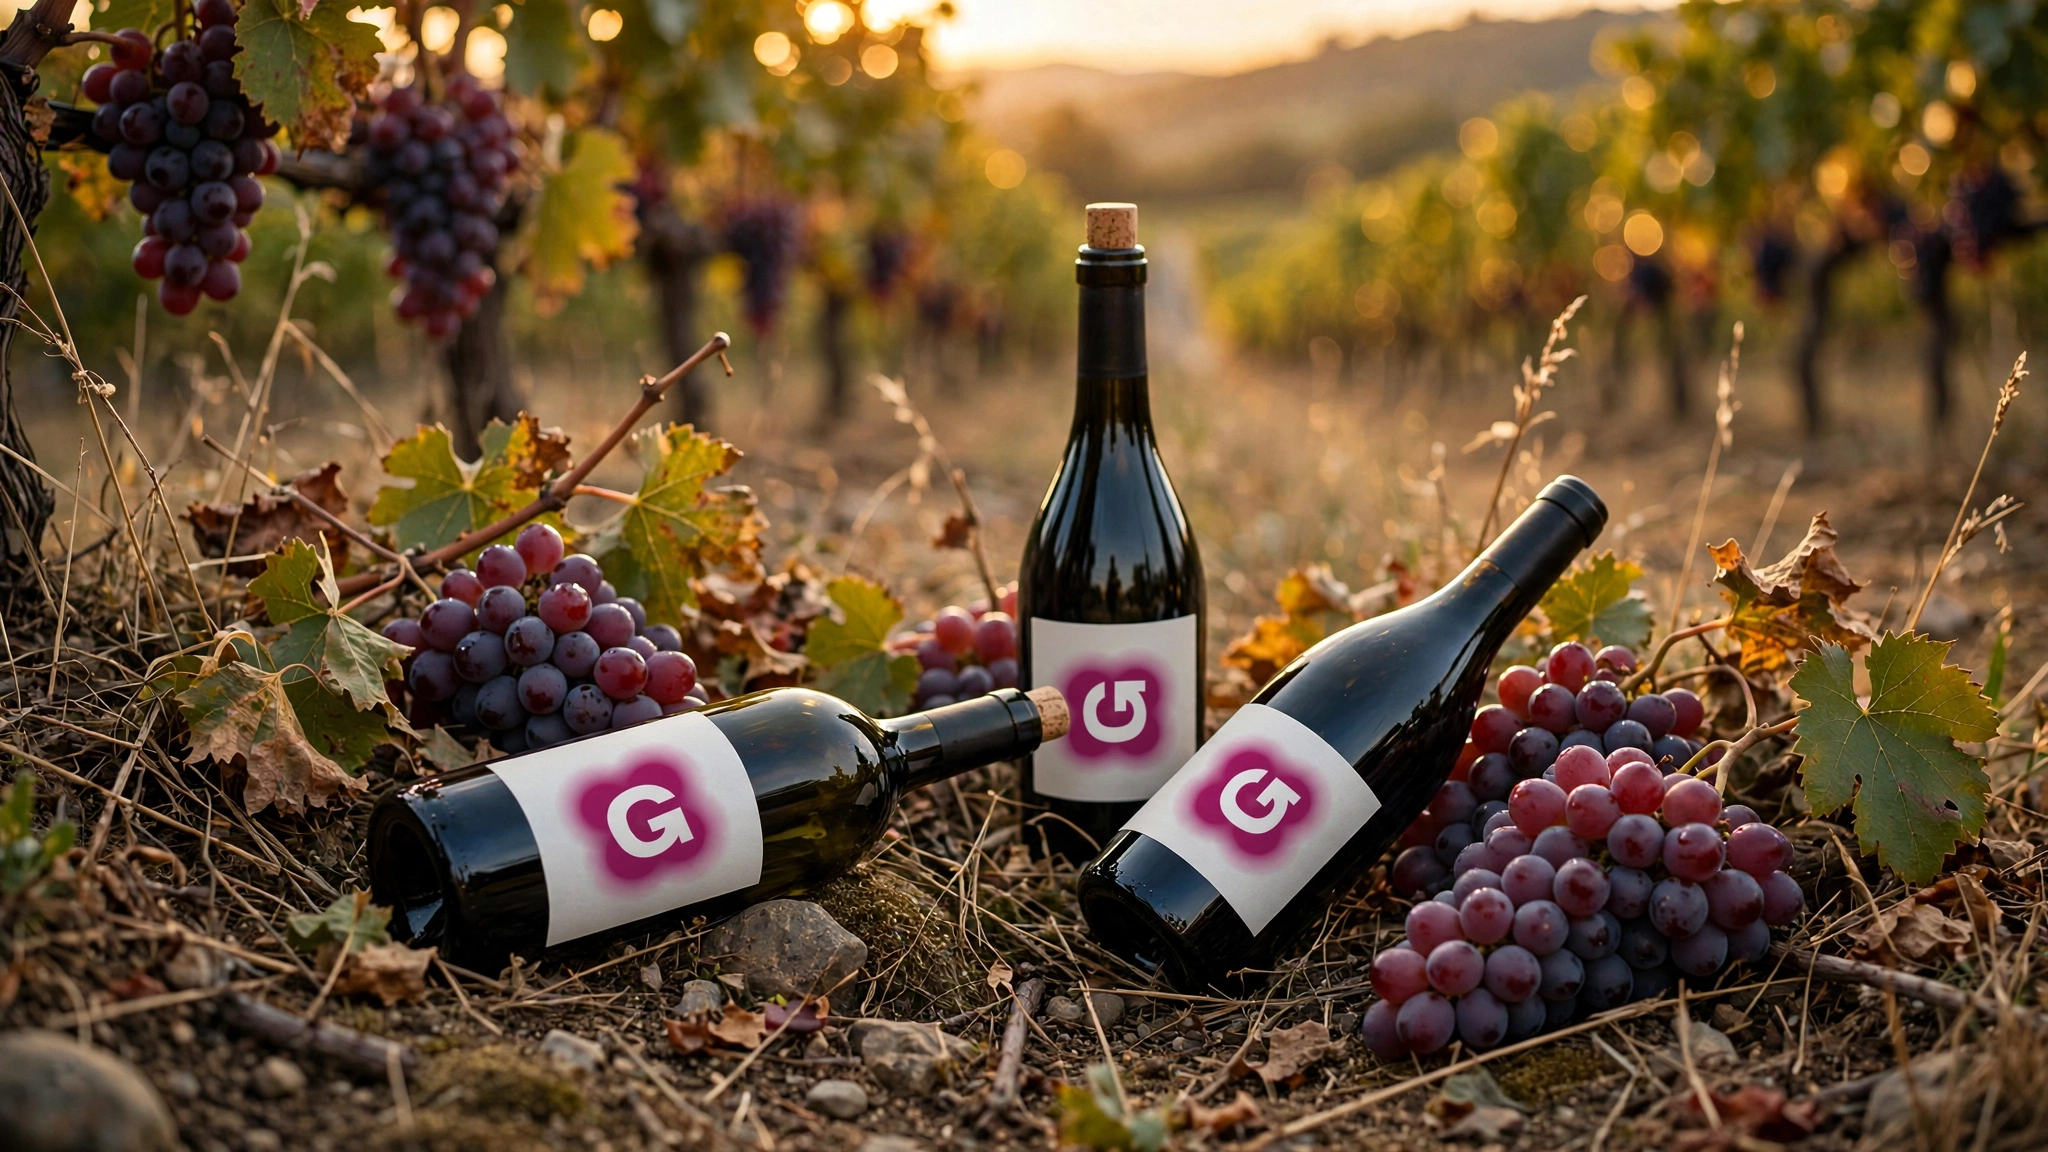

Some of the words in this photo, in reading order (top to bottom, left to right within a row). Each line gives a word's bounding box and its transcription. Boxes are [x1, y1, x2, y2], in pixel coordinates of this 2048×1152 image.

[1083, 680, 1147, 743] G
[607, 784, 694, 858] G
[1219, 768, 1301, 834] G
